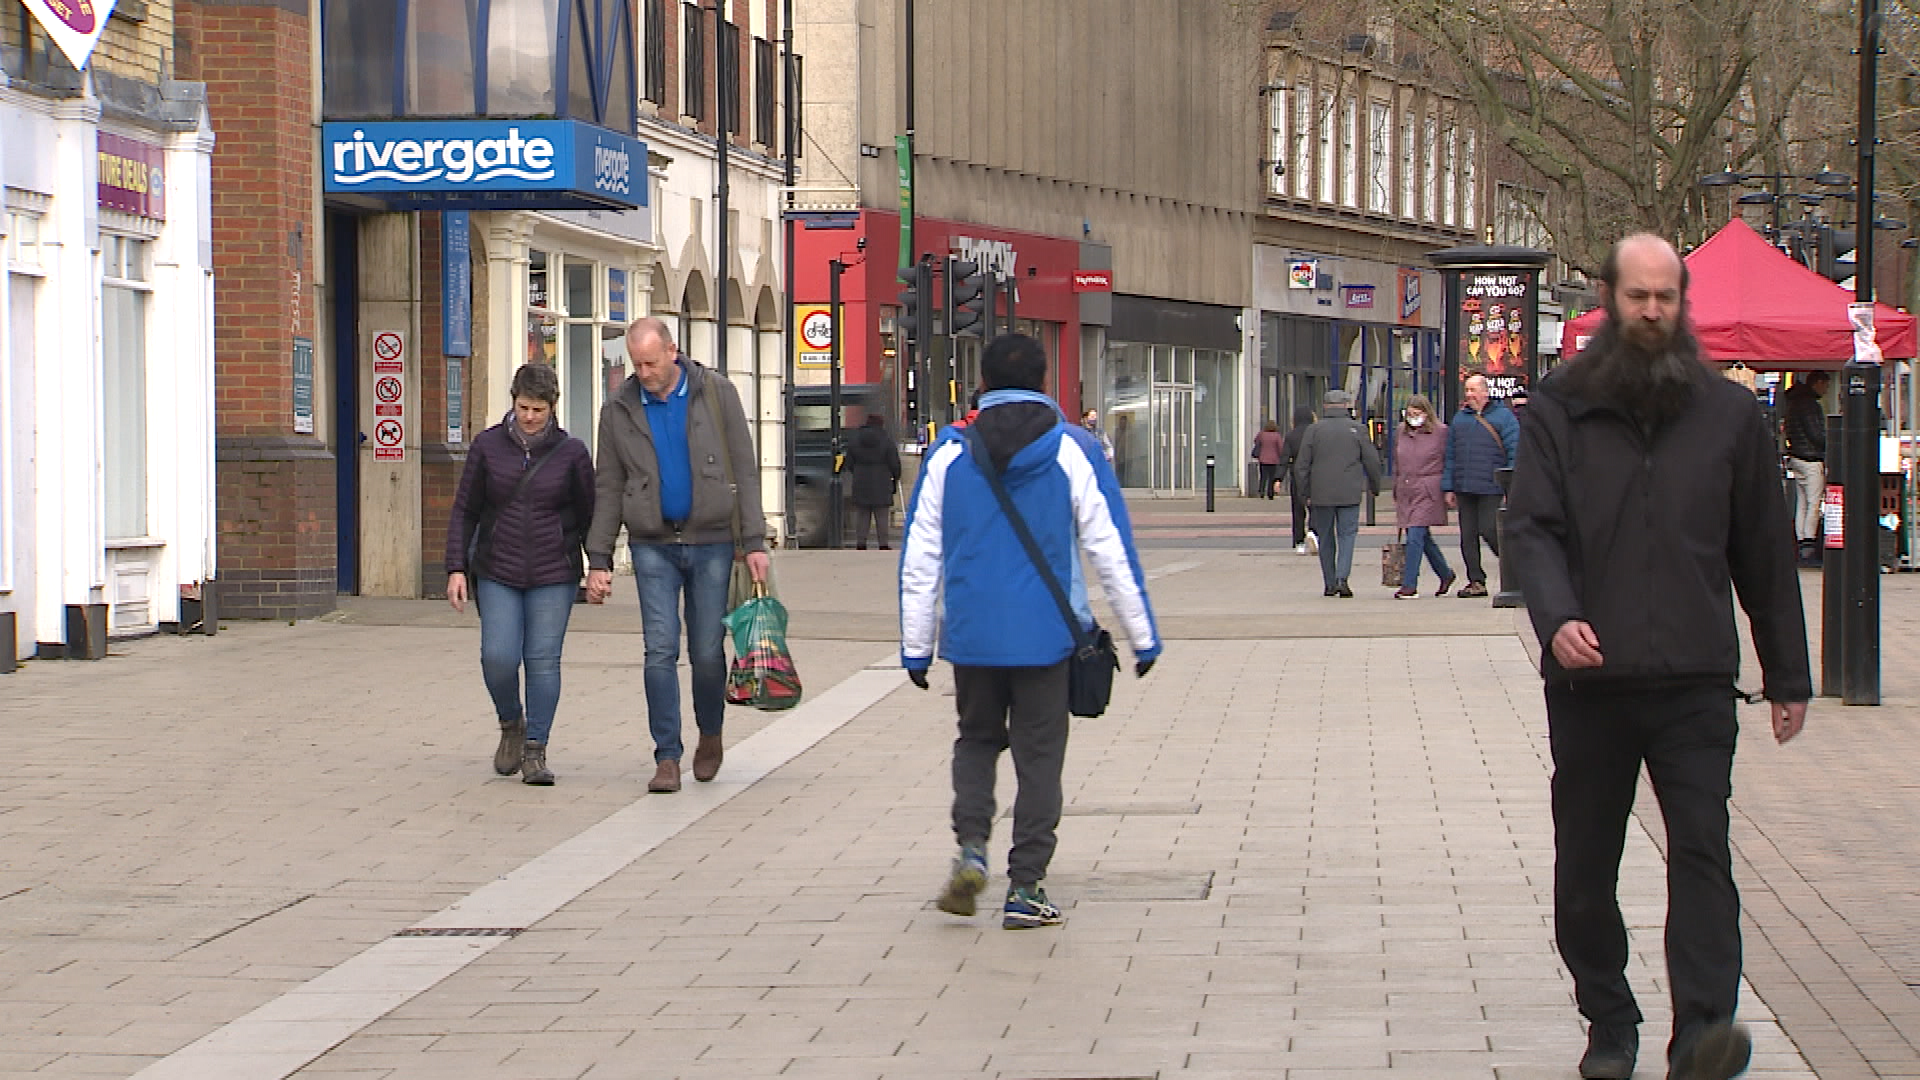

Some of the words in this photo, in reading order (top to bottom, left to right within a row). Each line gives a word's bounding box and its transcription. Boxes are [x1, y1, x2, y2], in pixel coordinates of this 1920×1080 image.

[333, 127, 555, 183] rivergate
[595, 135, 630, 194] rivergate
[123, 157, 148, 193] DEALS
[1466, 286, 1484, 296] CAN
[1485, 285, 1507, 297] YOU
[1507, 284, 1525, 297] GO?
[1474, 275, 1496, 286] HOW
[1498, 275, 1518, 286] HOT
[1498, 376, 1517, 387] HOT
